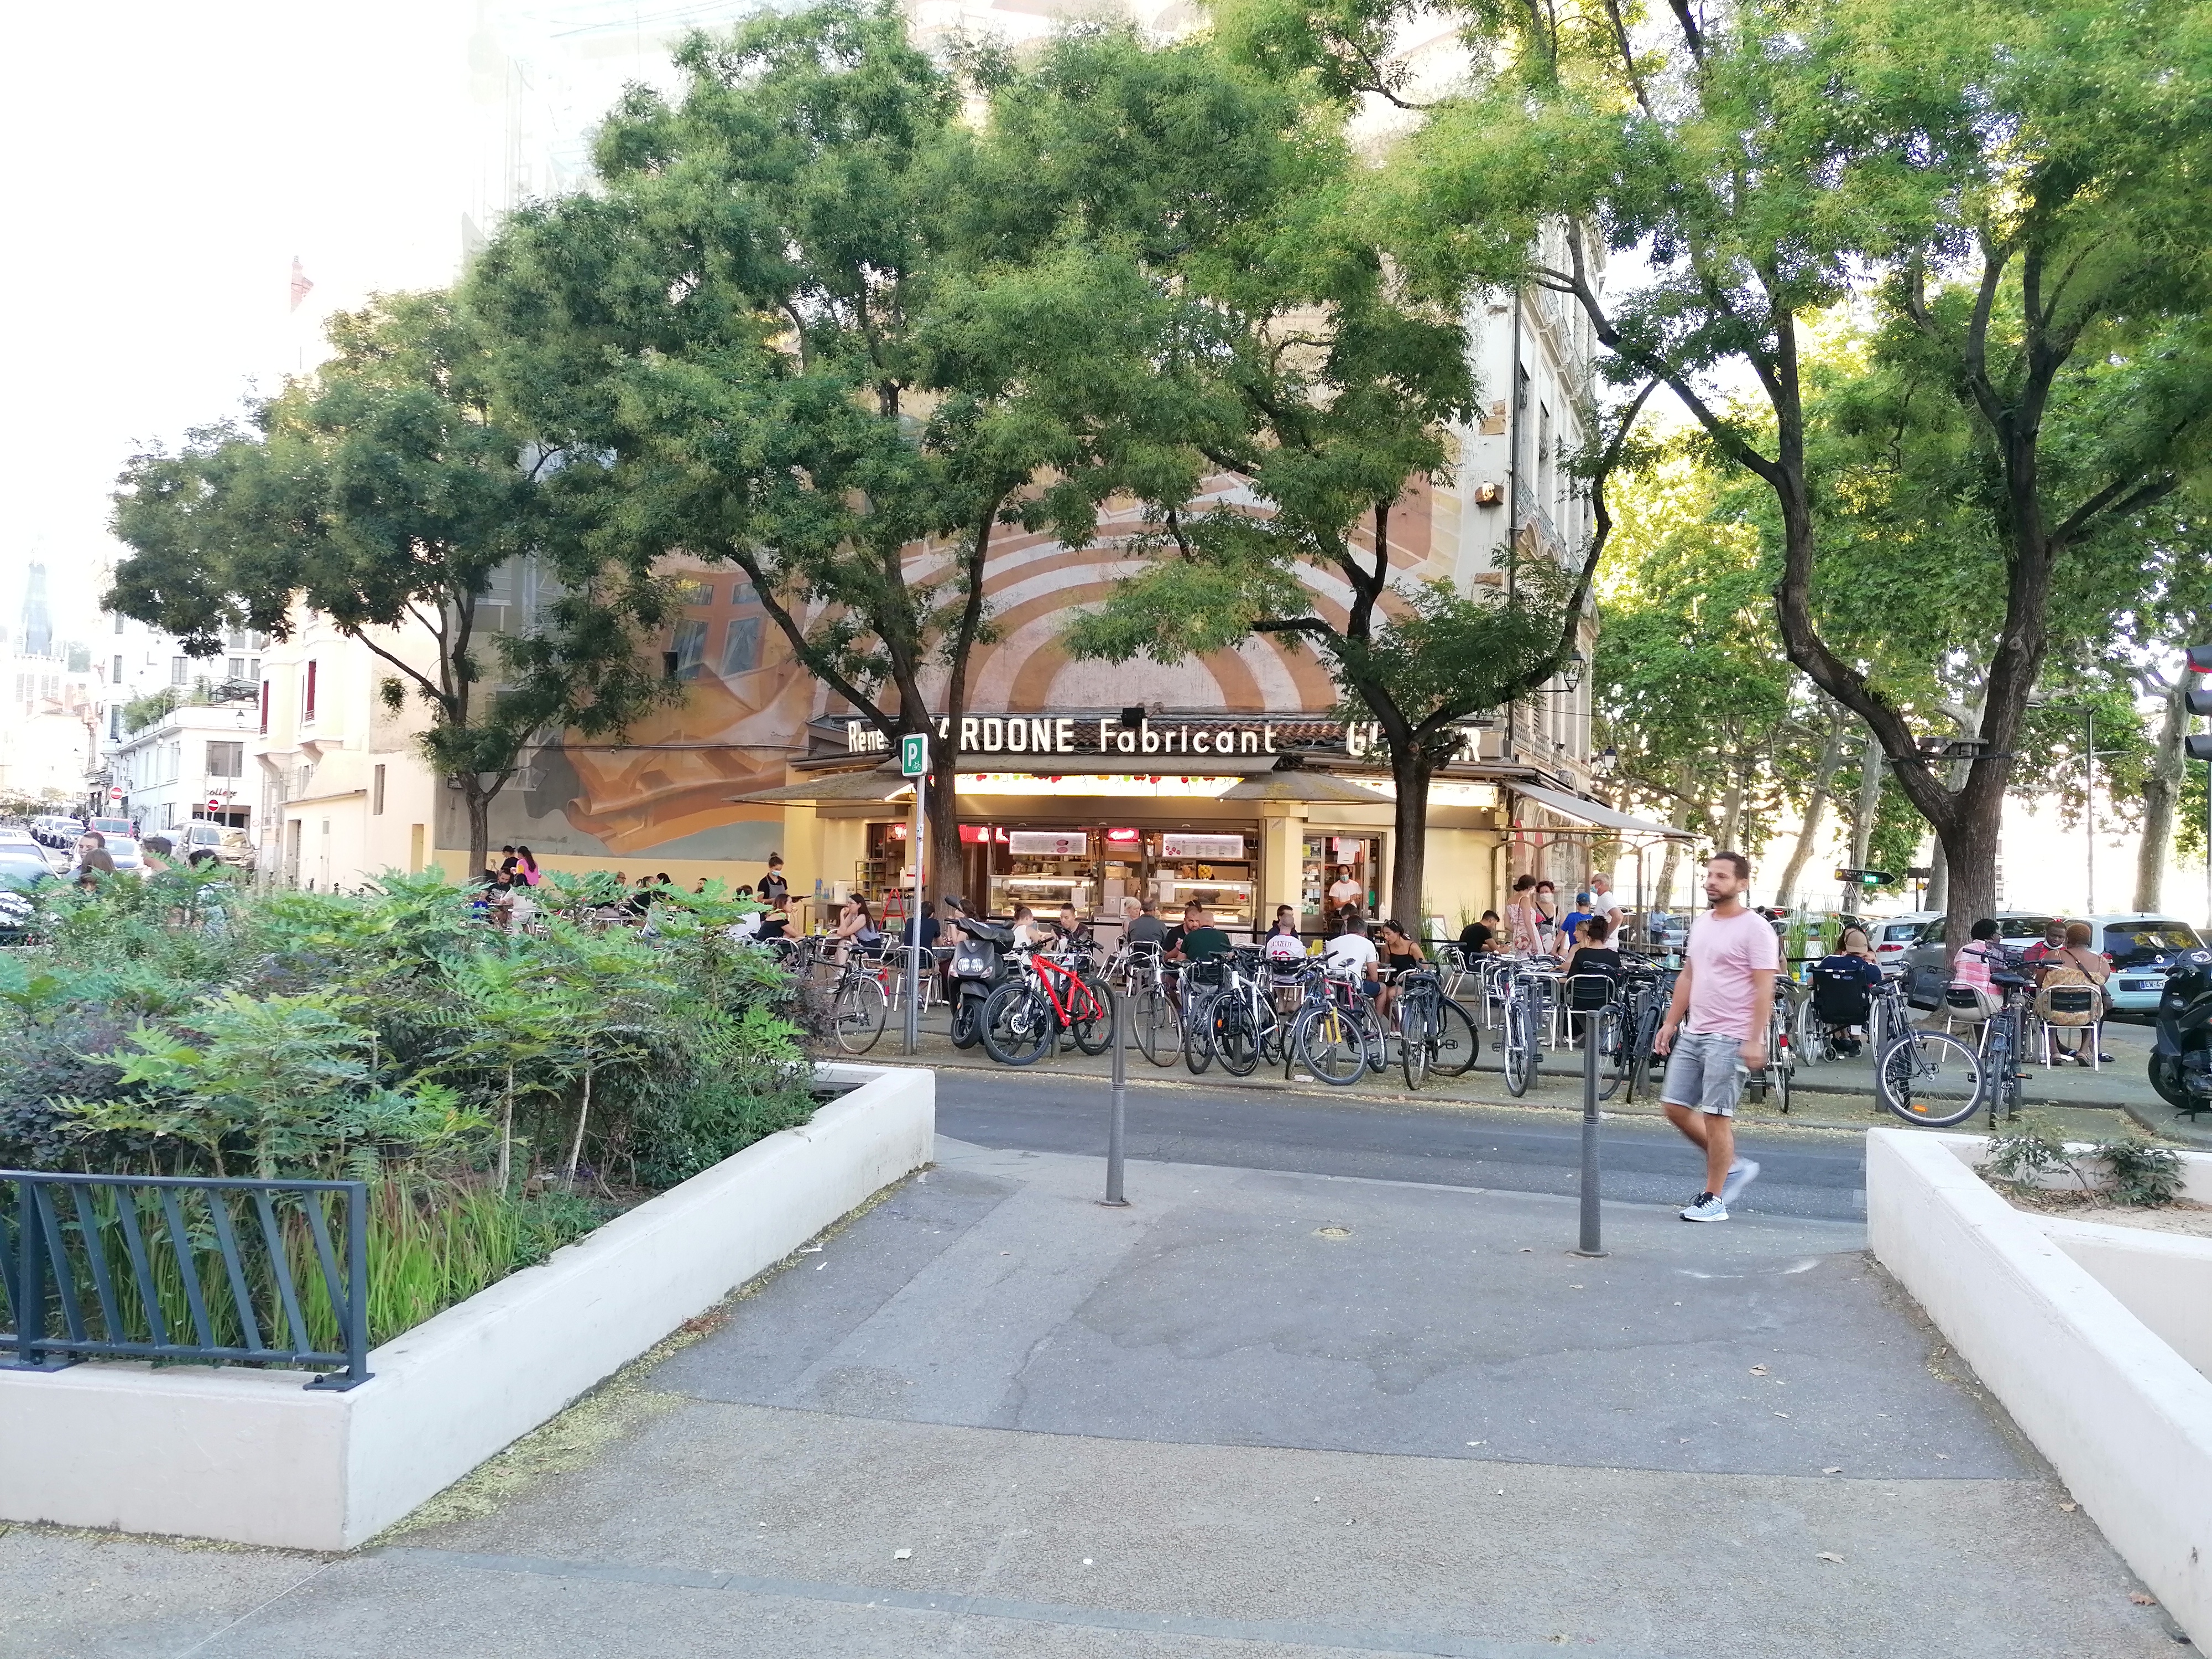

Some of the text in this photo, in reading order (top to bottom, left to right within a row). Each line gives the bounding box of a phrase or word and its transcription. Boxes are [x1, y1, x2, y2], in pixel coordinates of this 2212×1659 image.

[929, 717, 1074, 752] RDONE
[1100, 718, 1276, 753] Fabricant
[907, 743, 918, 767] P
